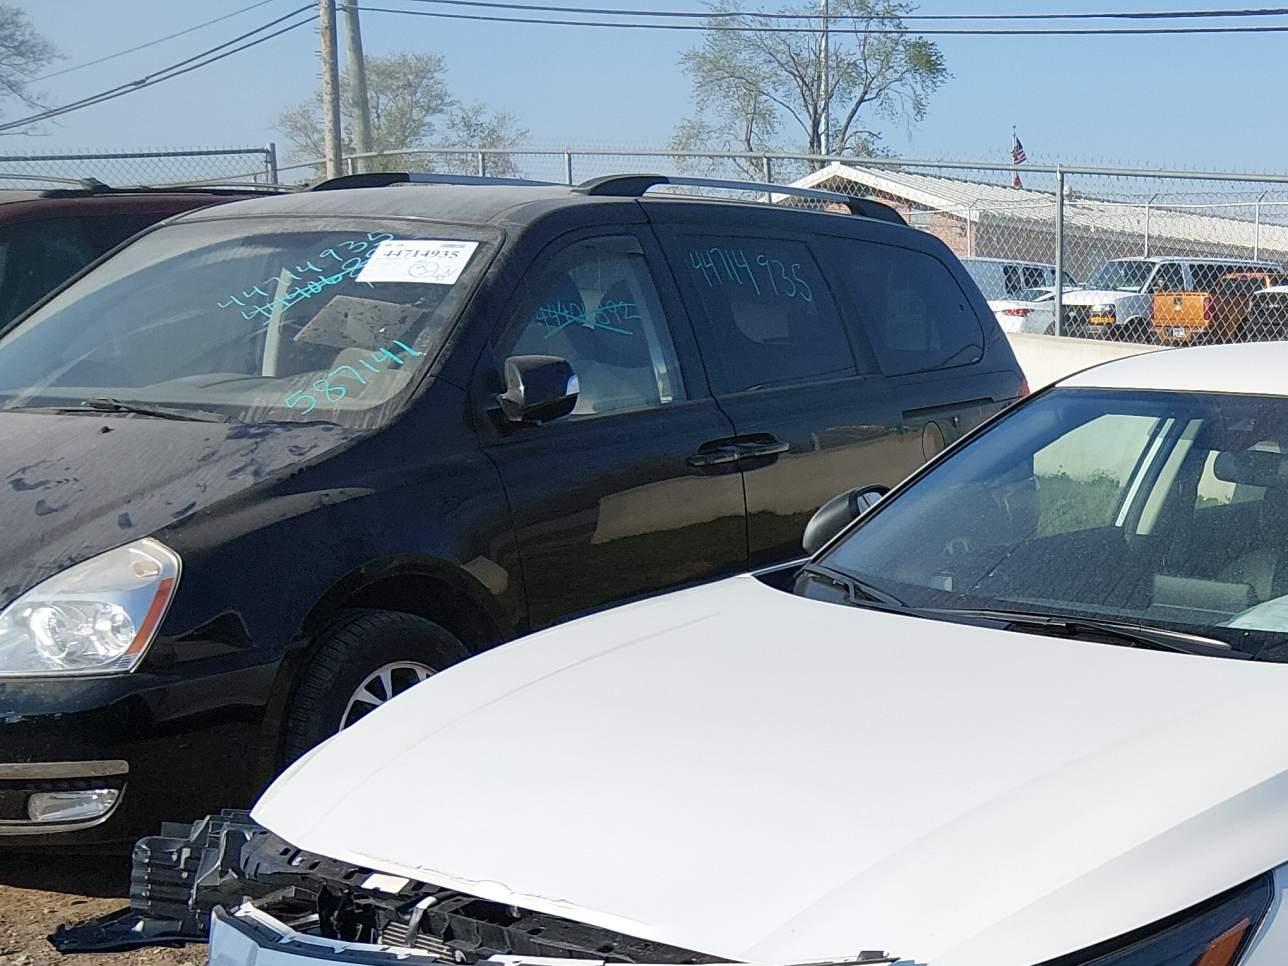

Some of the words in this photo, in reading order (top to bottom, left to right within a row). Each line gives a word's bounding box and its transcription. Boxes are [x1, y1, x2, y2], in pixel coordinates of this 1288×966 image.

[217, 231, 395, 309] 44714935
[382, 249, 461, 260] 44714935
[689, 247, 813, 302] 44714935
[284, 340, 418, 415] 587141
